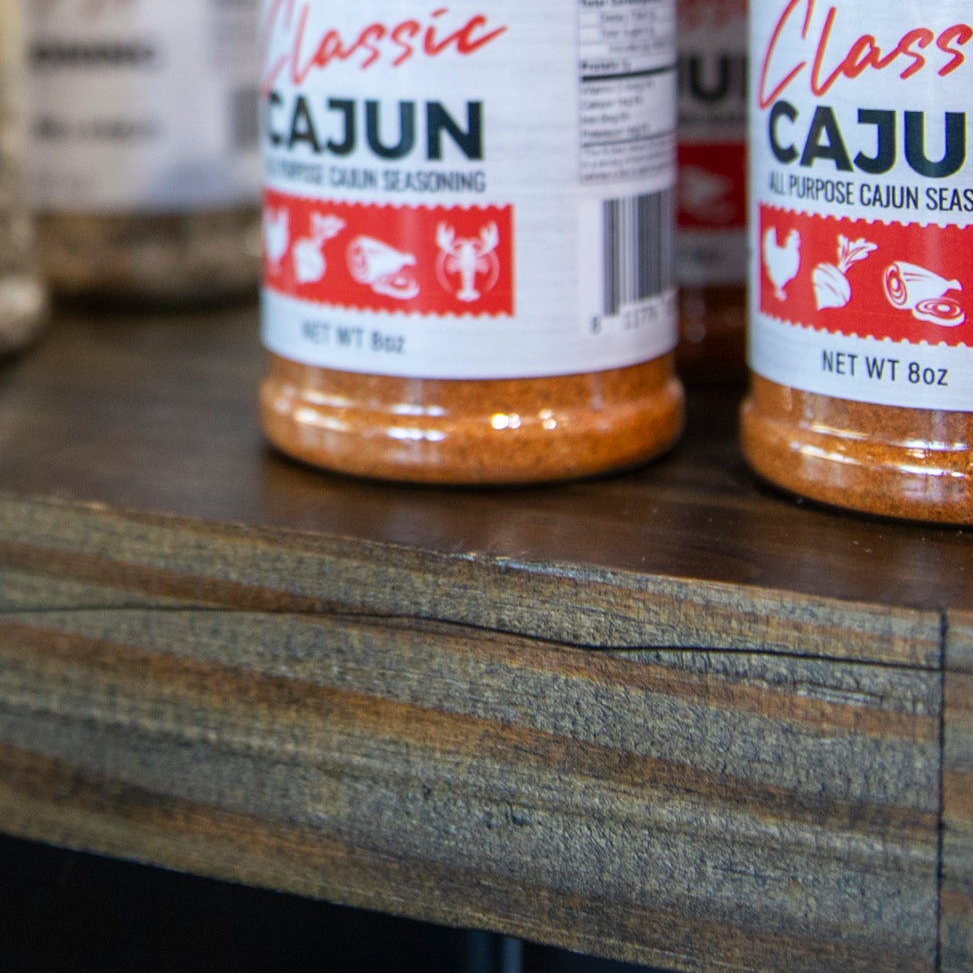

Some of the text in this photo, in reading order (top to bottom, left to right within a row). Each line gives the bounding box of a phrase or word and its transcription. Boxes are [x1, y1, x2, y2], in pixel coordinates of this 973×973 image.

[265, 92, 484, 161] CAJUN
[330, 168, 377, 190] CAJUN
[384, 169, 487, 194] SEASONING
[769, 172, 785, 195] ALL
[788, 177, 855, 206] PURPOSE
[859, 182, 919, 211] CAJUN
[302, 321, 406, 355] NET WT 8oz
[822, 350, 949, 387] NET WT 8oz
